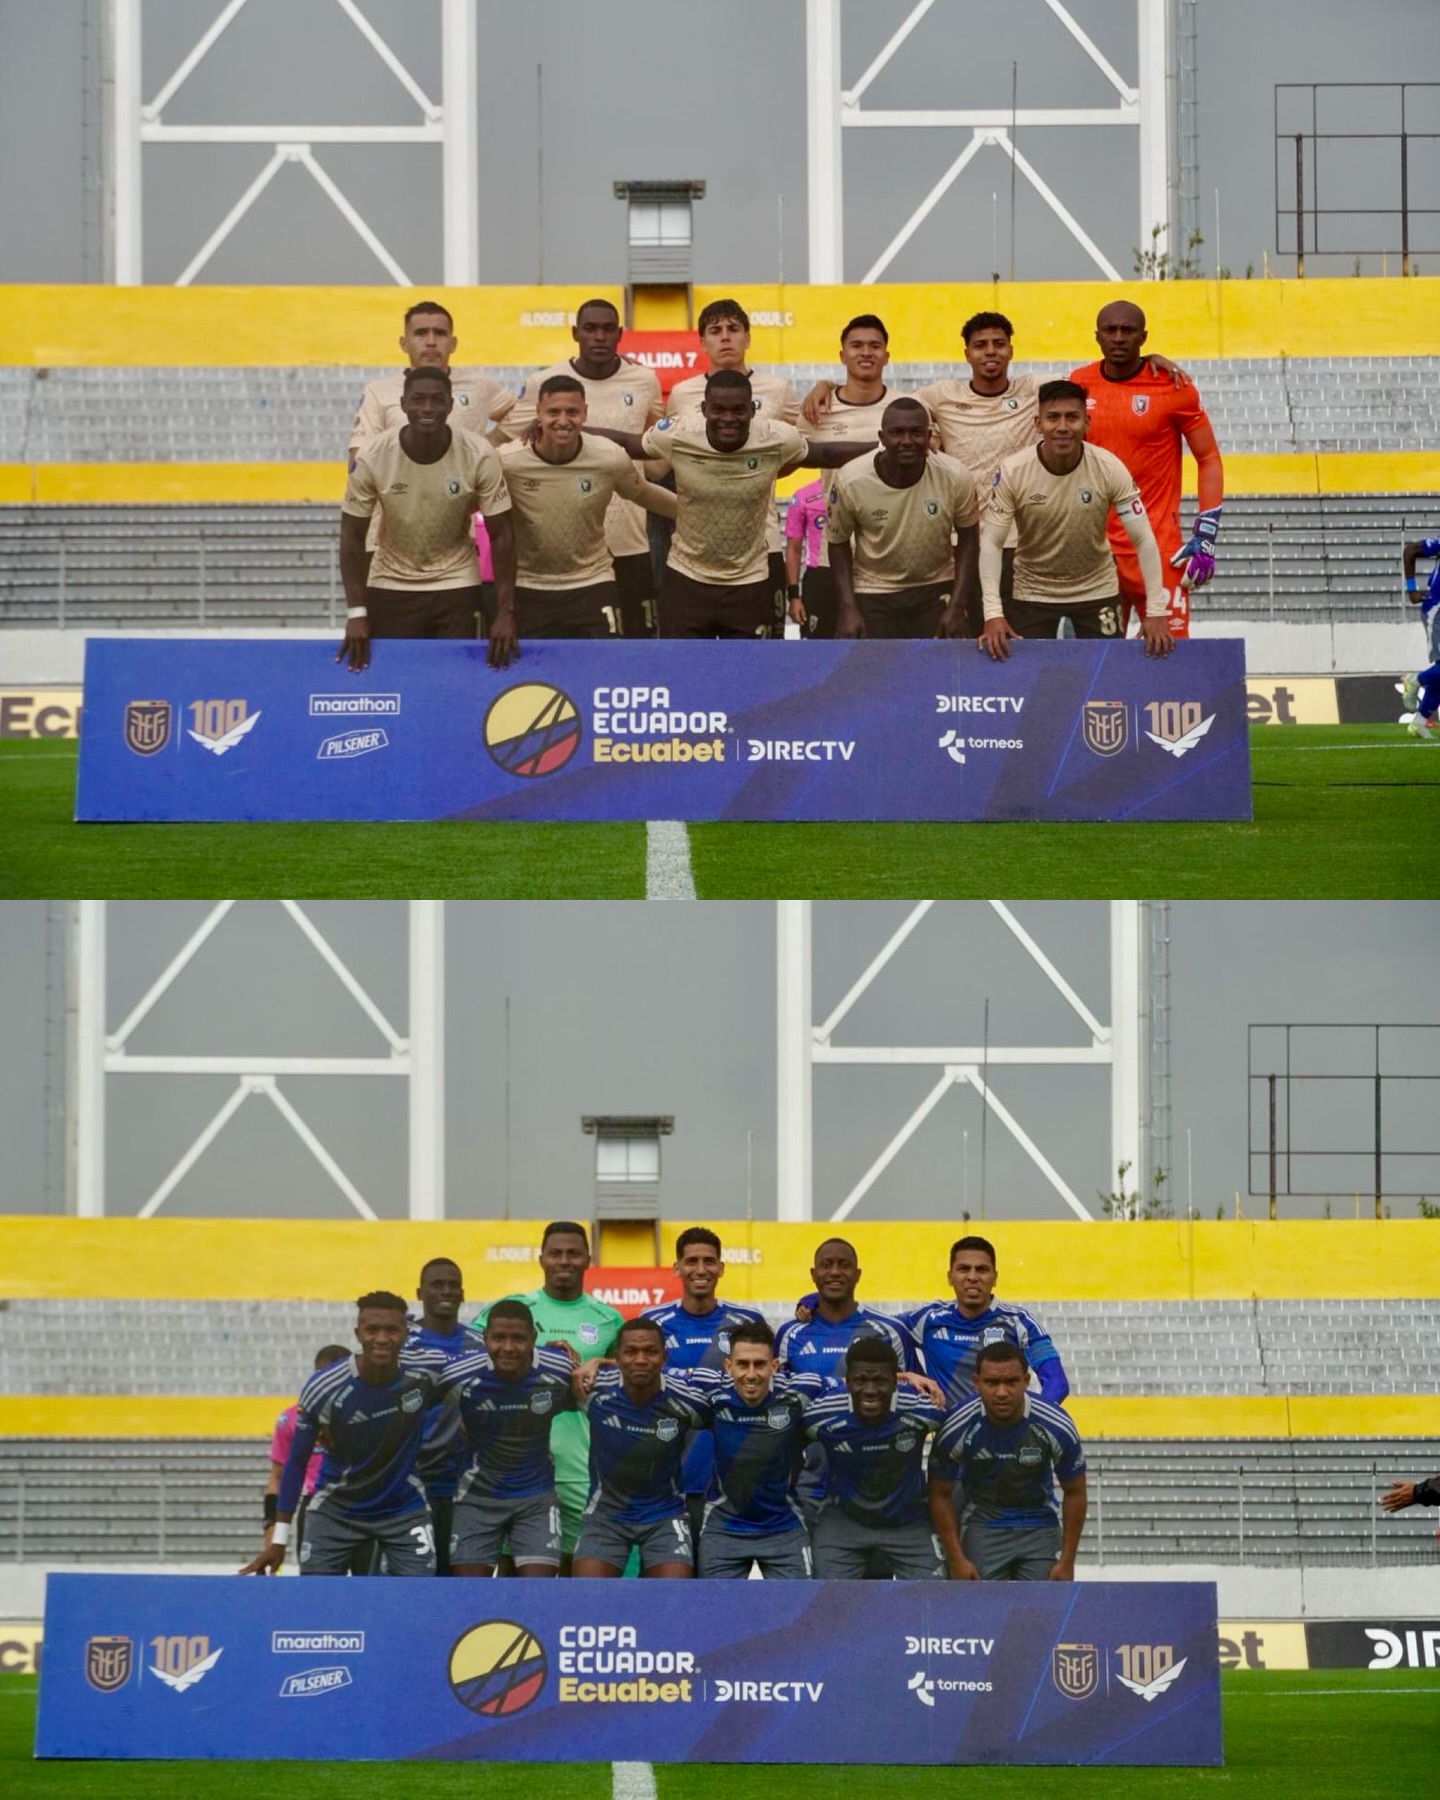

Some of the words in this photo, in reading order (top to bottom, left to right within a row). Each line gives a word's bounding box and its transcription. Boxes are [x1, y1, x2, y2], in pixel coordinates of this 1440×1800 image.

[685, 352, 698, 368] 7
[1131, 500, 1142, 515] C
[314, 697, 396, 712] marathon
[593, 687, 670, 709] COPA
[935, 694, 1025, 713] DIRECTV
[0, 697, 82, 739] Ec
[188, 699, 248, 741] 100
[593, 712, 728, 734] ECUADOR
[1143, 701, 1202, 743] 100
[326, 732, 380, 756] PILSENER
[593, 738, 725, 762] Ecuabet
[747, 739, 856, 761] DIRECTV
[967, 736, 1024, 749] torneos
[652, 1288, 665, 1305] 7
[277, 1634, 360, 1649] marathon
[559, 1626, 637, 1648] COPA
[905, 1636, 995, 1656] DIRECTV
[150, 1635, 210, 1678] 100
[559, 1651, 695, 1674] ECUADOR
[1115, 1644, 1173, 1687] 100
[289, 1670, 344, 1694] PILSENER
[559, 1677, 692, 1702] Ecuabet
[714, 1679, 824, 1702] DIRECTV
[936, 1678, 993, 1692] torneos
